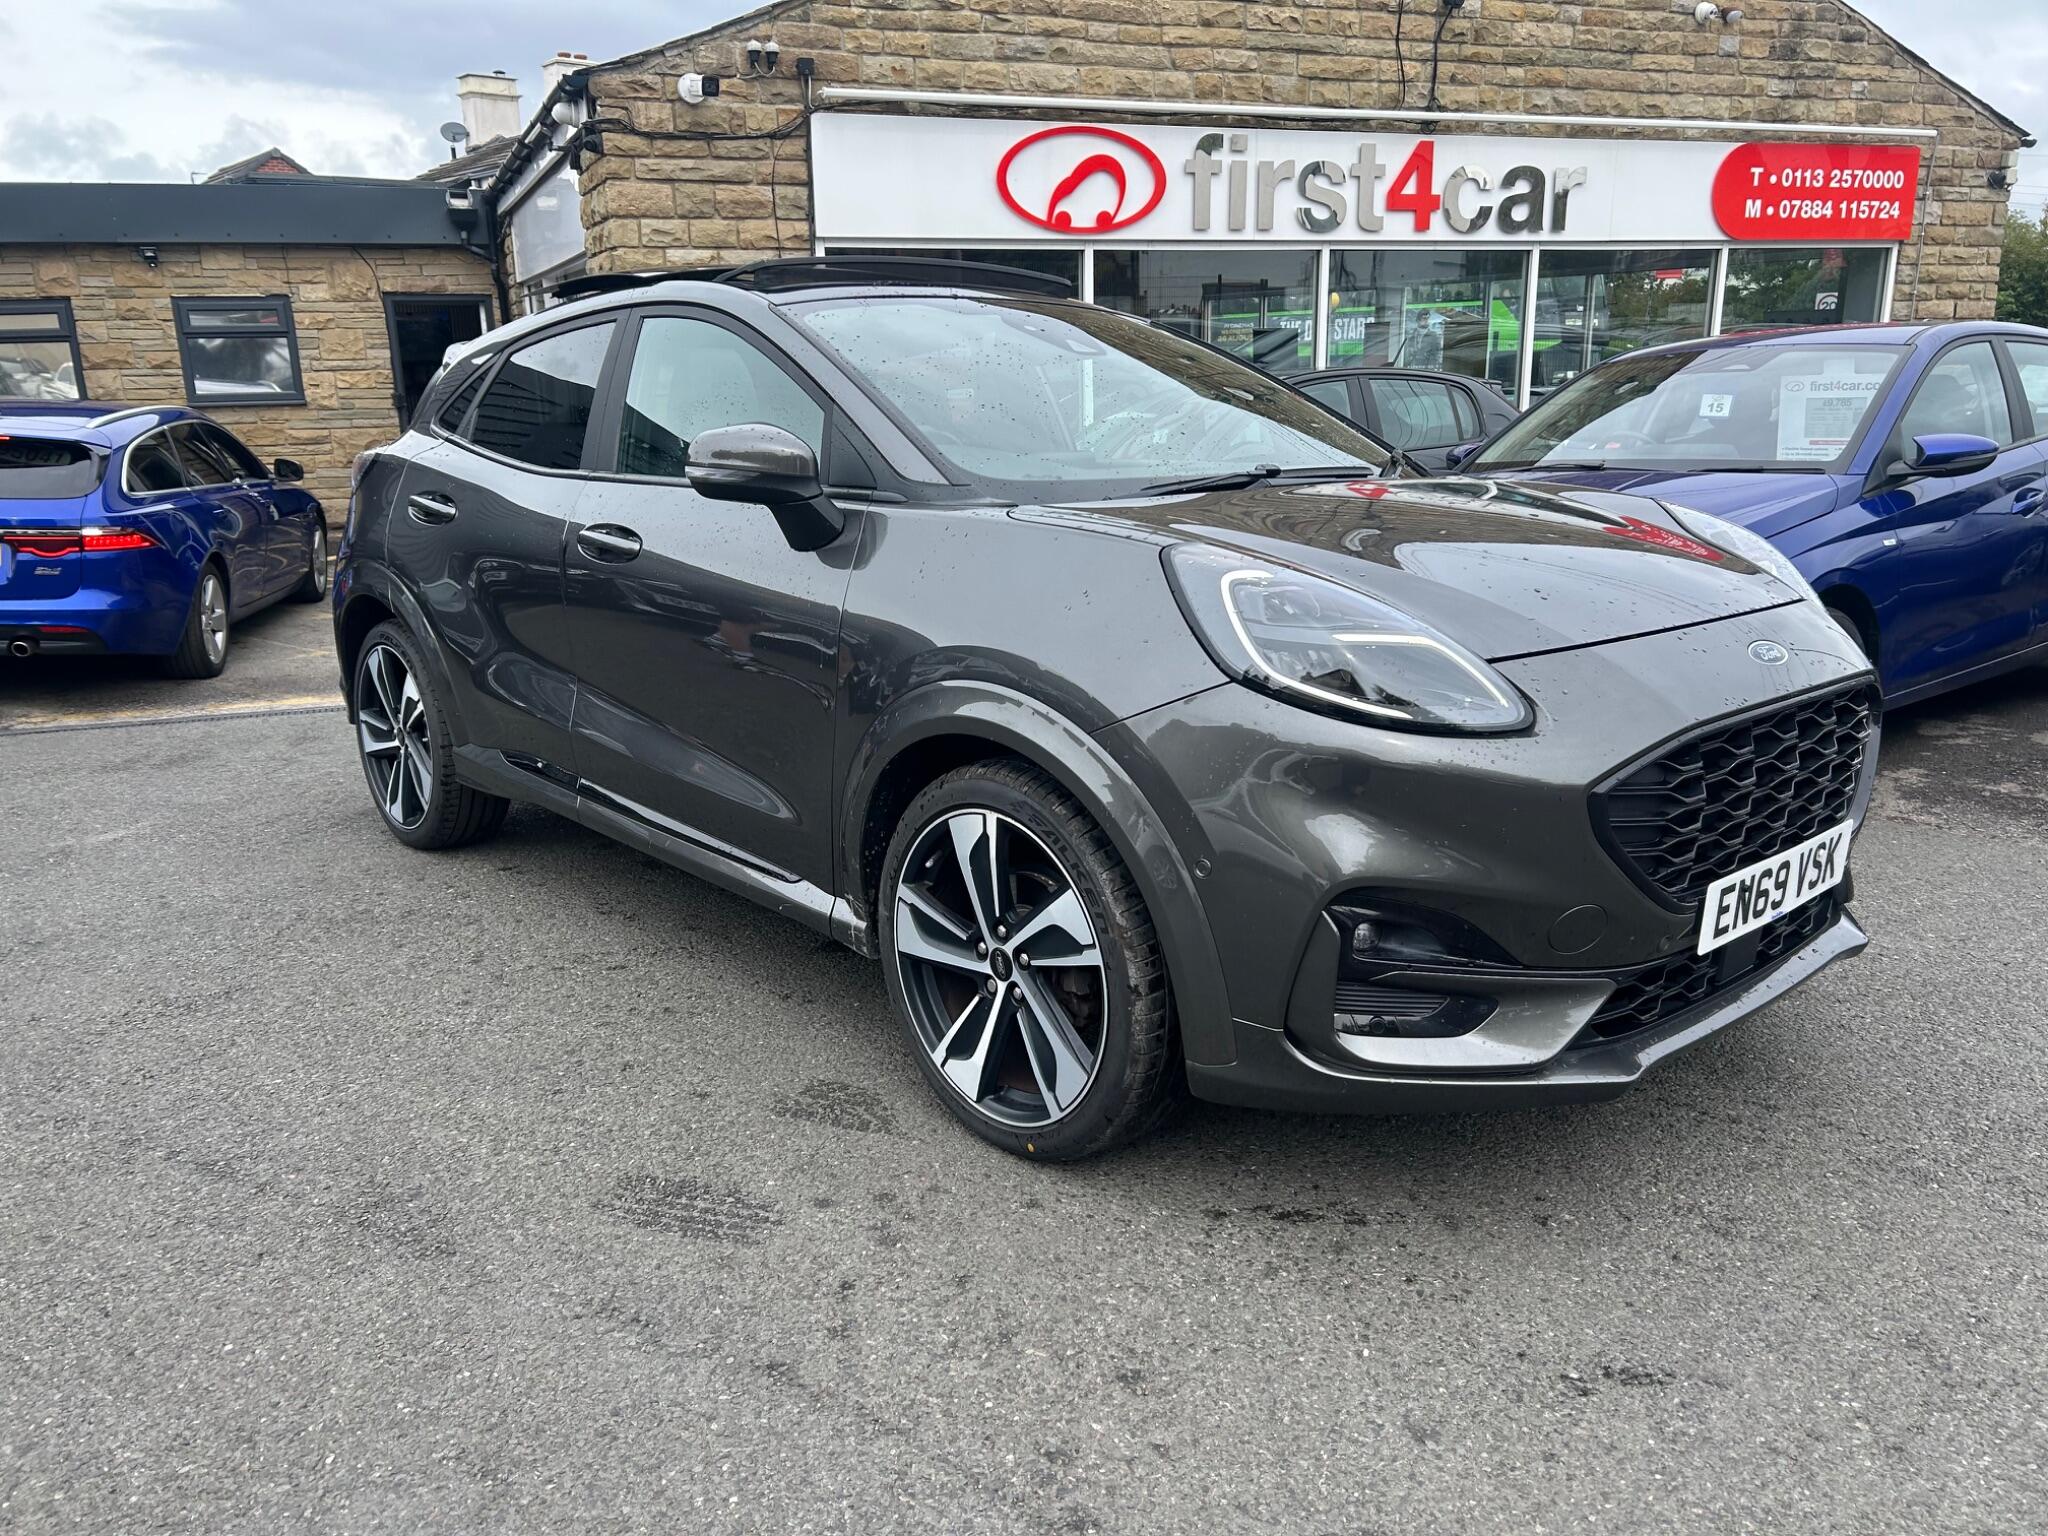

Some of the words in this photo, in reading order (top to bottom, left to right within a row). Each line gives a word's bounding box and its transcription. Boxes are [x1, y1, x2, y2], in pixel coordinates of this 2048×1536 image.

[1184, 133, 1588, 234] first4car
[1750, 167, 1764, 187] T
[1781, 168, 1824, 188] 0113
[1829, 169, 1905, 189] 2570000
[1744, 199, 1762, 219] M
[1779, 199, 1833, 219] 07884
[1839, 200, 1900, 219] 115724
[1810, 380, 1881, 392] first4car.co
[1707, 402, 1725, 413] 15
[1712, 859, 1791, 940] EN69
[1796, 832, 1843, 899] VSK
